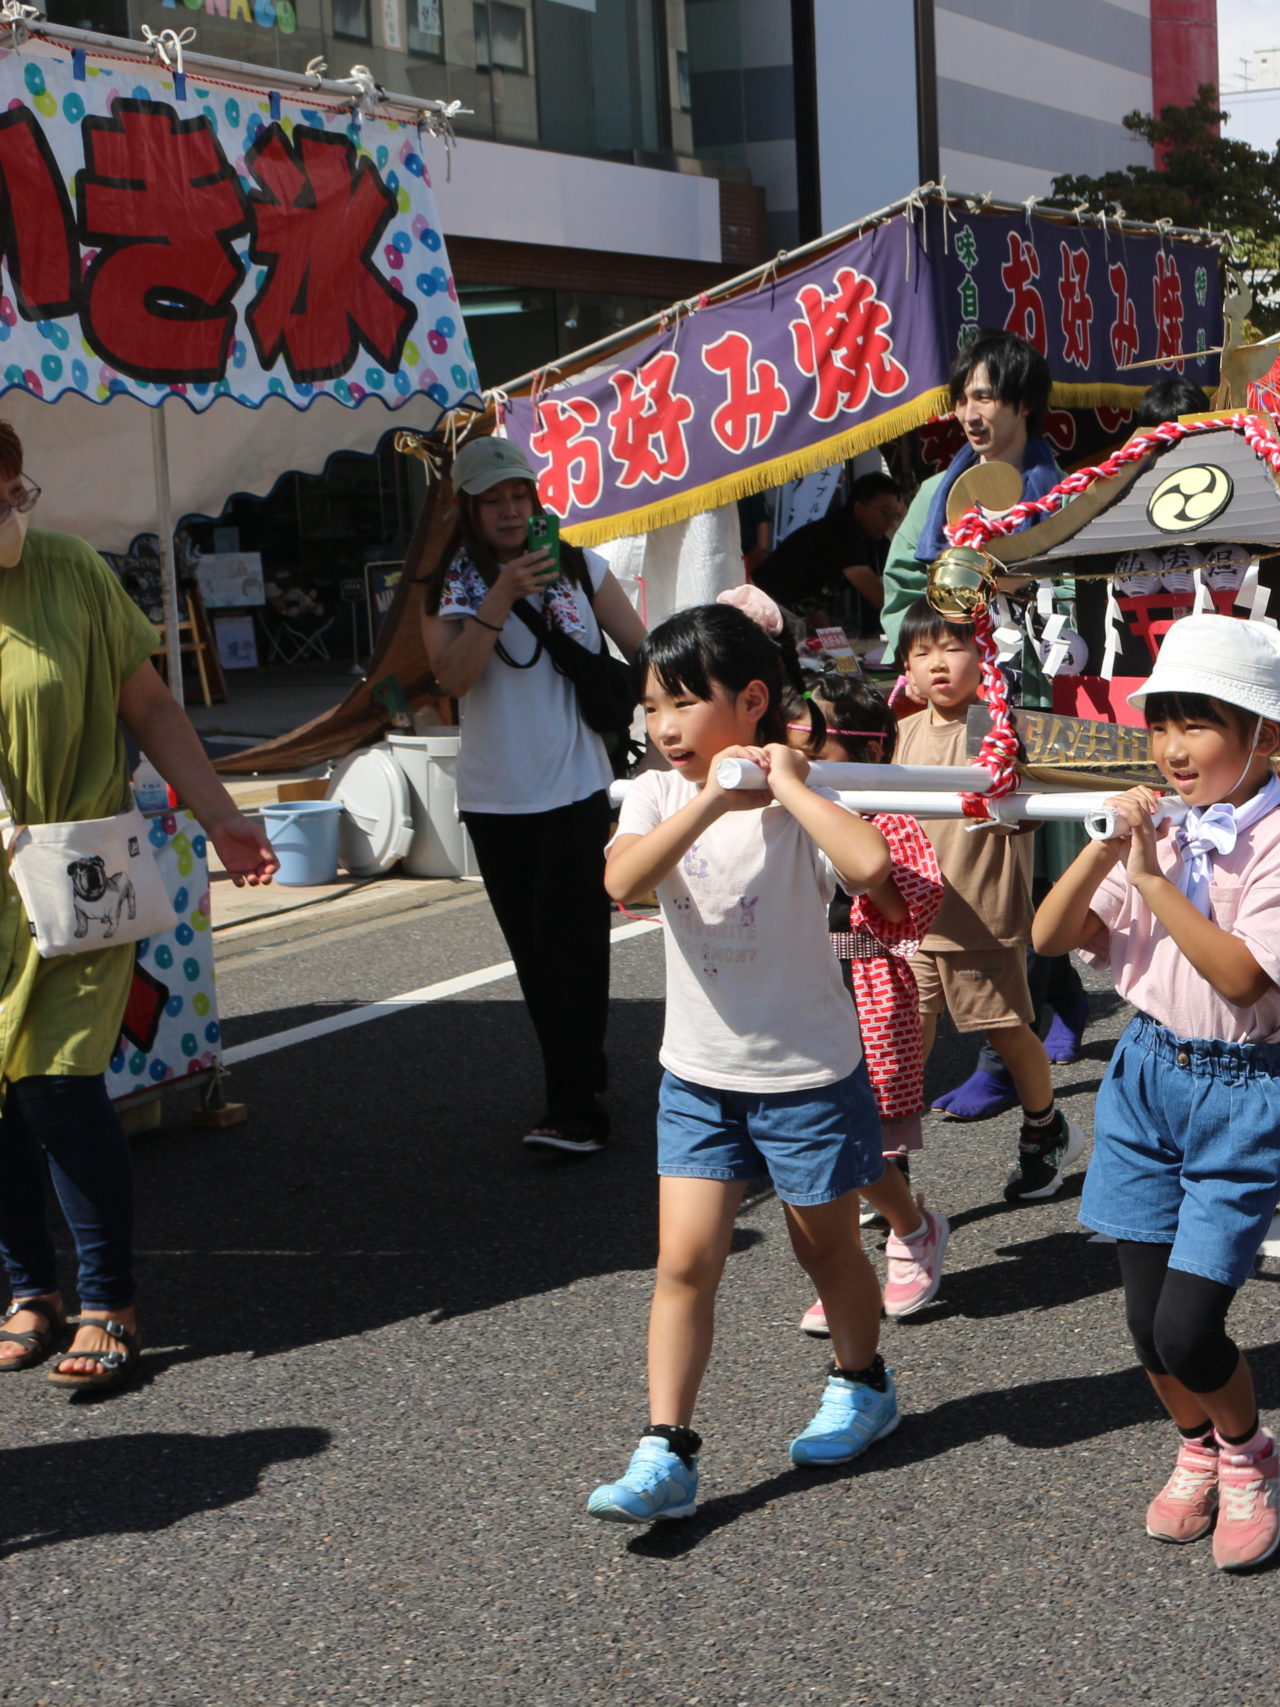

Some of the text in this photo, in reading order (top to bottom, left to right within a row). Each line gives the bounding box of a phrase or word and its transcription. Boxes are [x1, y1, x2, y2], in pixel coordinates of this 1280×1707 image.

[530, 266, 909, 518] お好み焼
[1001, 230, 1184, 375] お好み焼
